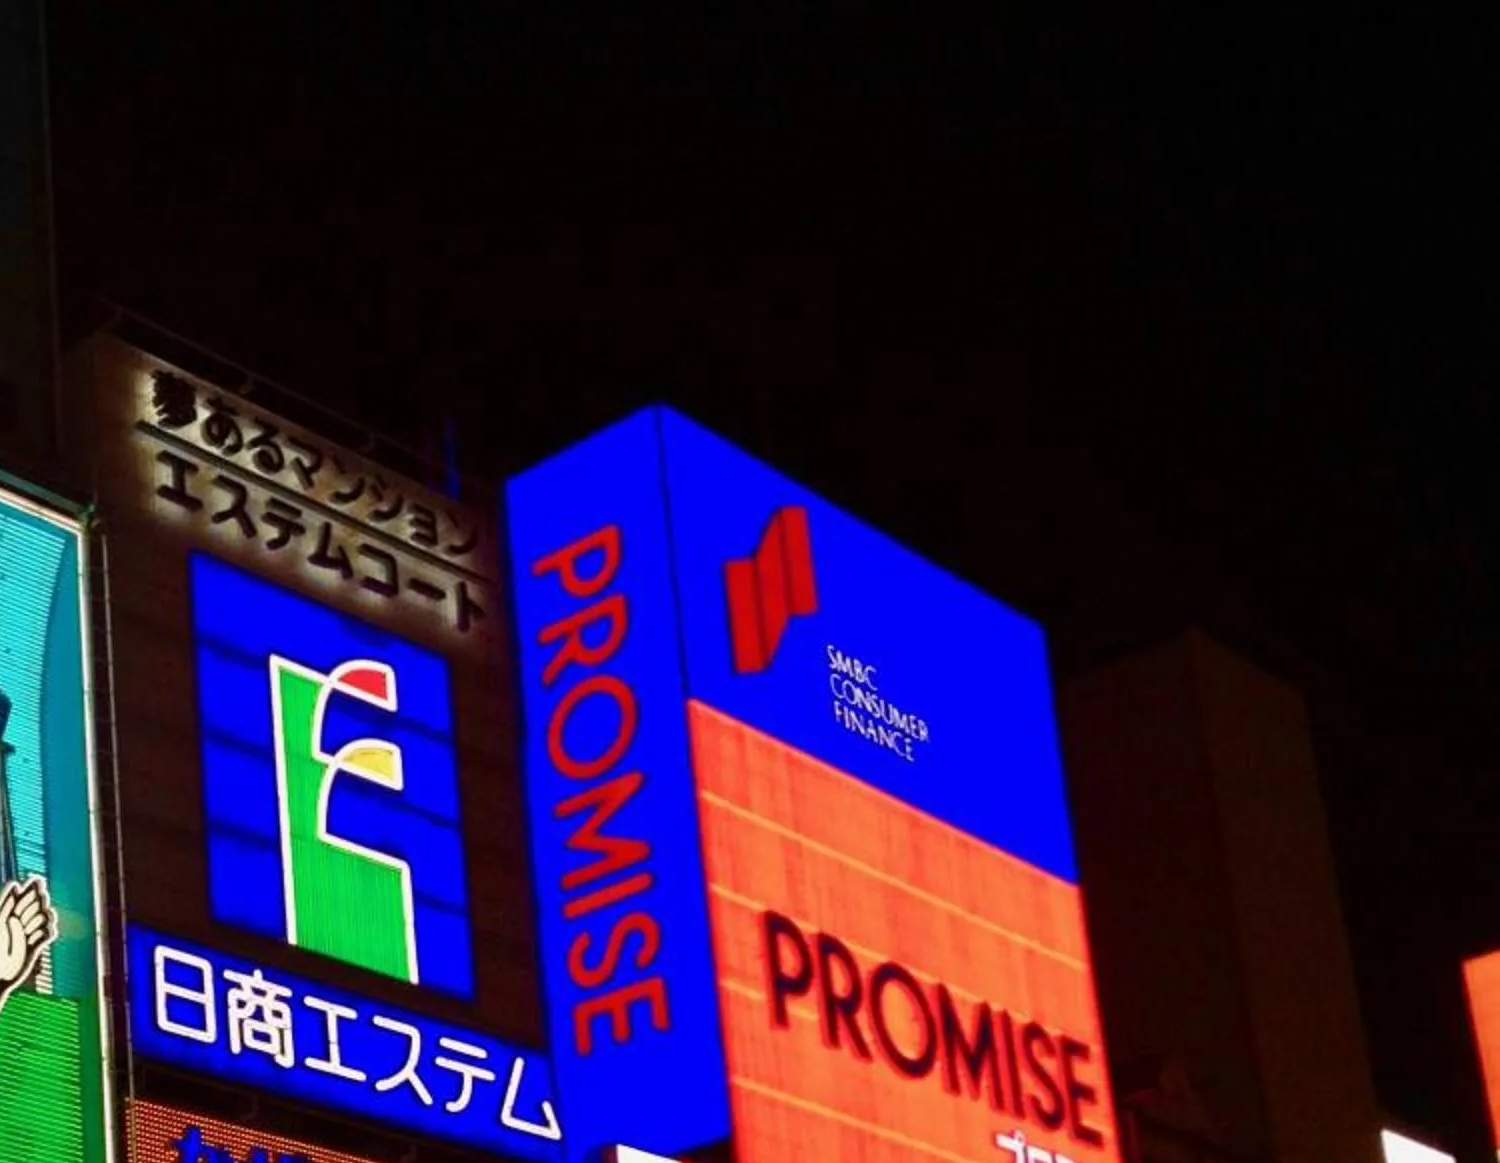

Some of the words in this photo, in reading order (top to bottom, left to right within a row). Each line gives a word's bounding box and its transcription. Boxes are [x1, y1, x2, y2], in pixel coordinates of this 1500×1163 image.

[156, 450, 485, 633] エステムコート
[827, 644, 879, 691] SMBC
[829, 673, 930, 743] CONSUMER
[834, 700, 915, 762] FINANCE
[531, 524, 672, 1056] PROMISE
[153, 945, 563, 1142] 日商エステム
[761, 908, 1104, 1149] PROMISE
